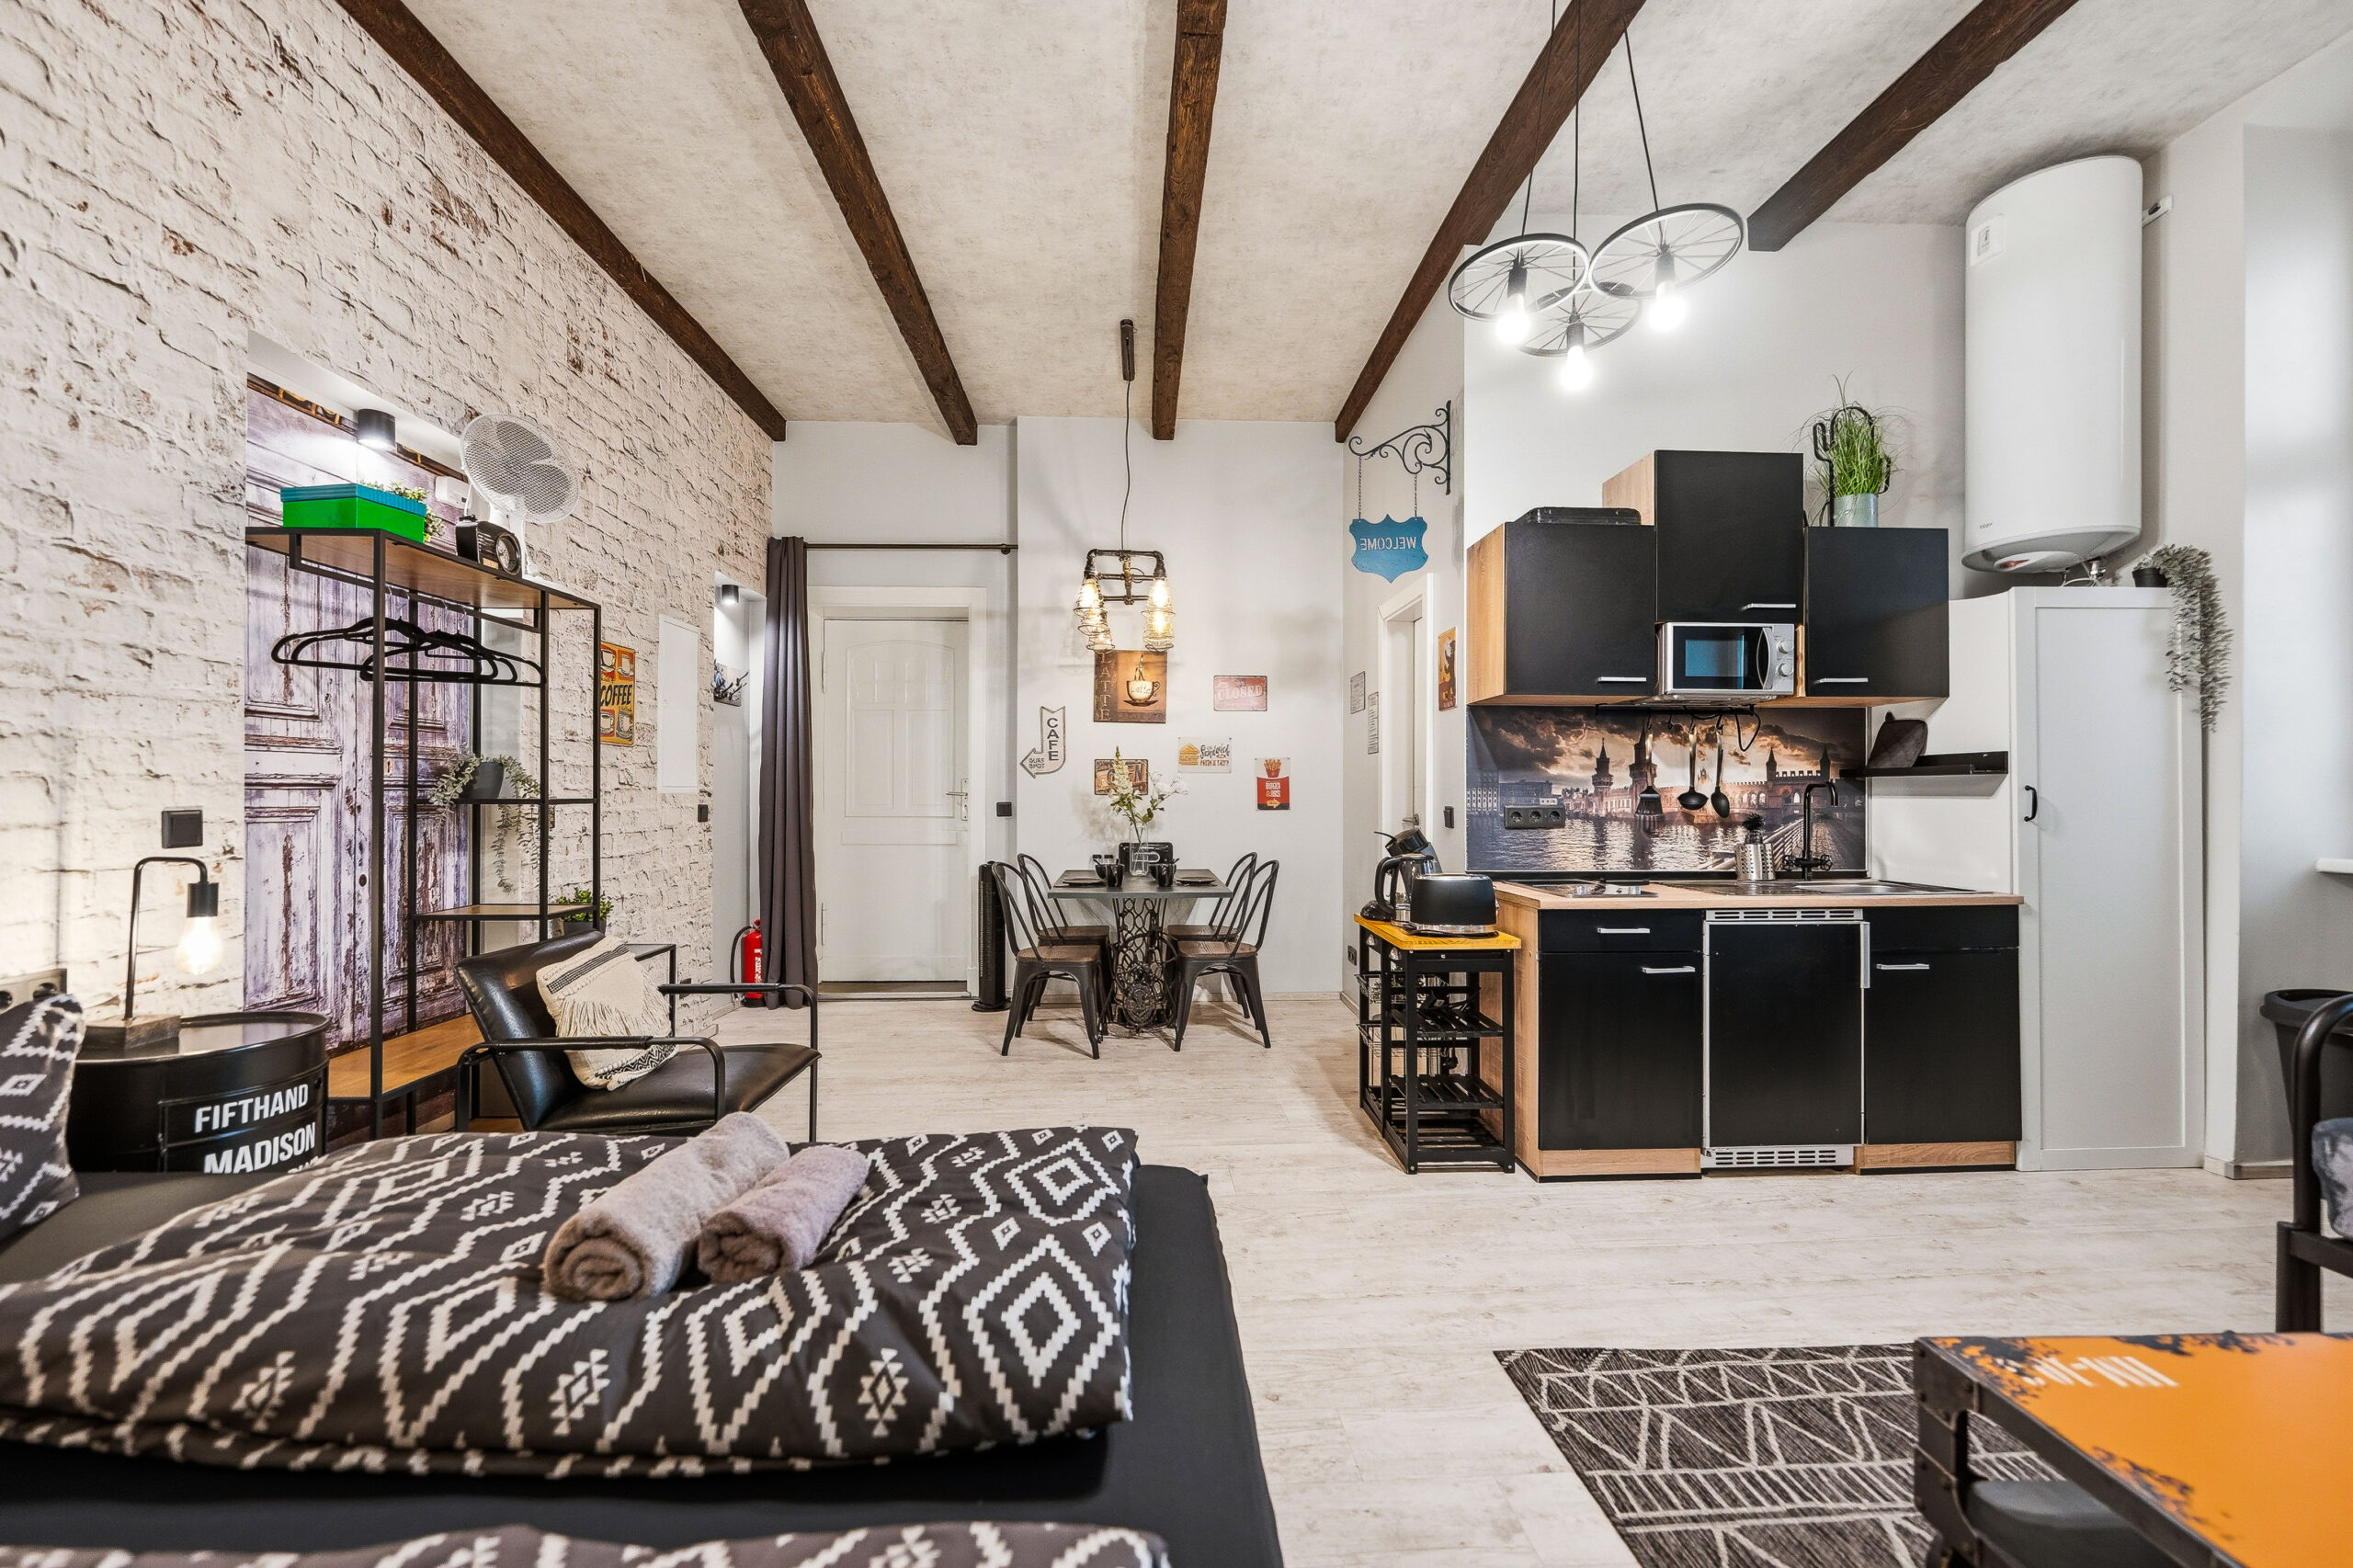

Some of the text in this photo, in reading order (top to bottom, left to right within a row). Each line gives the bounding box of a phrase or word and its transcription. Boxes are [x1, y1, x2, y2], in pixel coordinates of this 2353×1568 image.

[600, 684, 632, 706] COFFEE
[1098, 653, 1111, 722] LATTE
[1217, 685, 1264, 701] CLOSED
[1047, 717, 1059, 761] CAFE
[194, 1084, 309, 1134] FIFTHAND
[203, 1121, 316, 1175] MADISON
